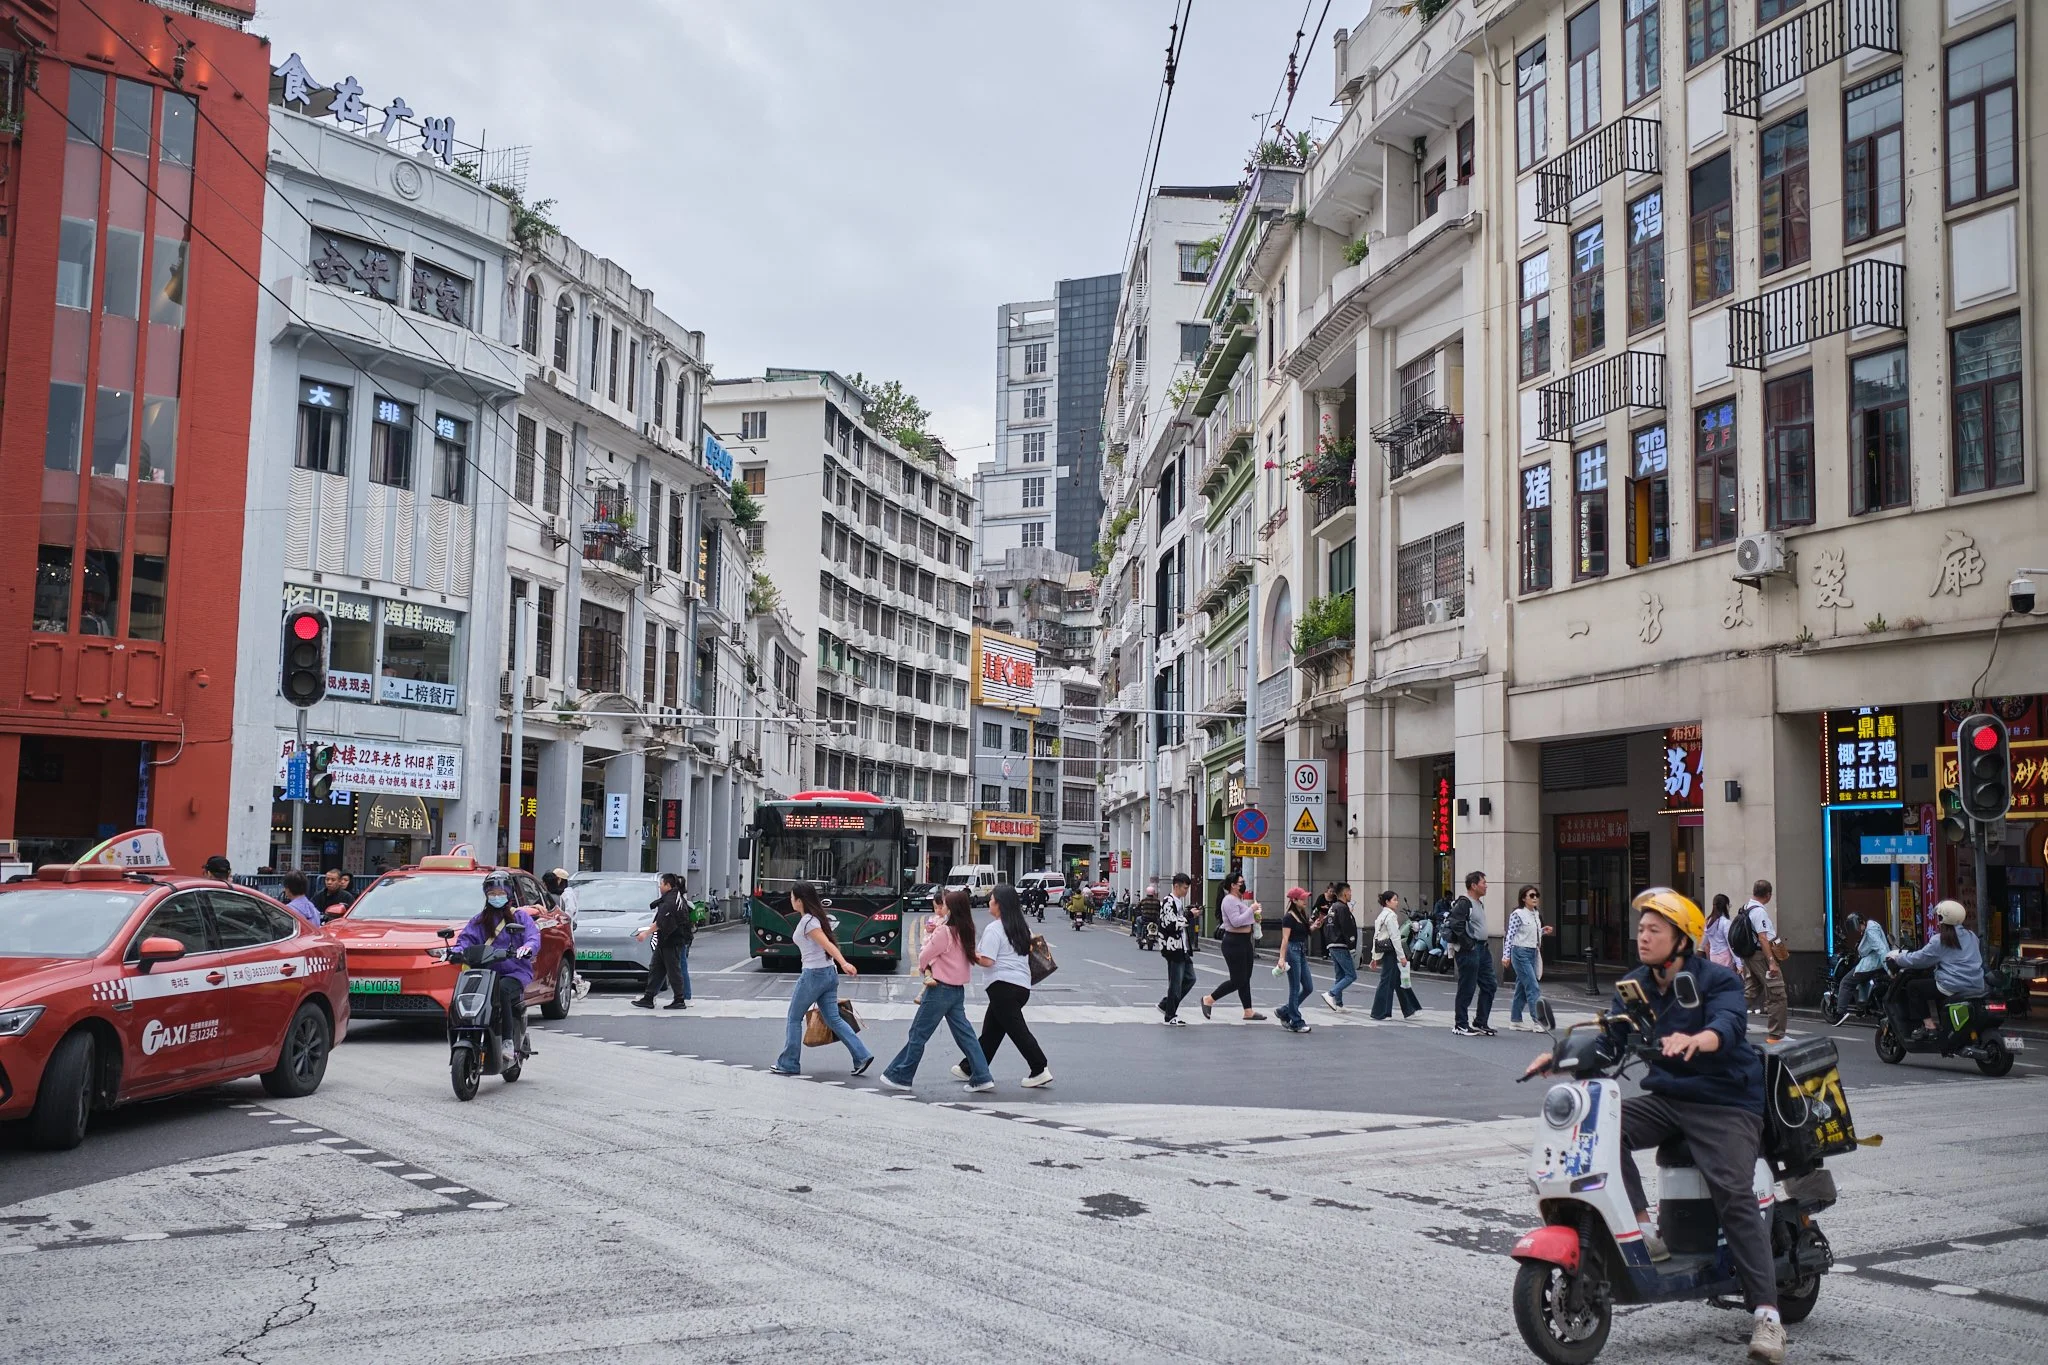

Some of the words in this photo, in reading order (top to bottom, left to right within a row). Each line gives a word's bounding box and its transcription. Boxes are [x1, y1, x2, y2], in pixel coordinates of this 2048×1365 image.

[273, 53, 455, 165] 食在广州
[308, 385, 455, 439] 大排档
[1526, 426, 1667, 510] 猪肚鸡
[283, 585, 370, 622] 怀旧骑楼
[384, 601, 456, 635] 海鲜研究部
[401, 683, 455, 705] 上榜餐厅
[359, 750, 402, 767] 22年老店
[404, 753, 434, 770] 怀旧菜
[437, 754, 455, 767] 宵夜
[1837, 739, 1896, 766] 椰子鸡
[1299, 771, 1314, 784] 30
[1665, 746, 1703, 798] 荔
[1838, 765, 1897, 790] 猪肚鸡
[1237, 845, 1268, 856] 严管路段
[1291, 836, 1320, 846] 学校区域
[1873, 837, 1913, 847] 大南路
[171, 977, 190, 989] 电动车
[364, 980, 400, 992] CY0033
[198, 1027, 218, 1041] 12345
